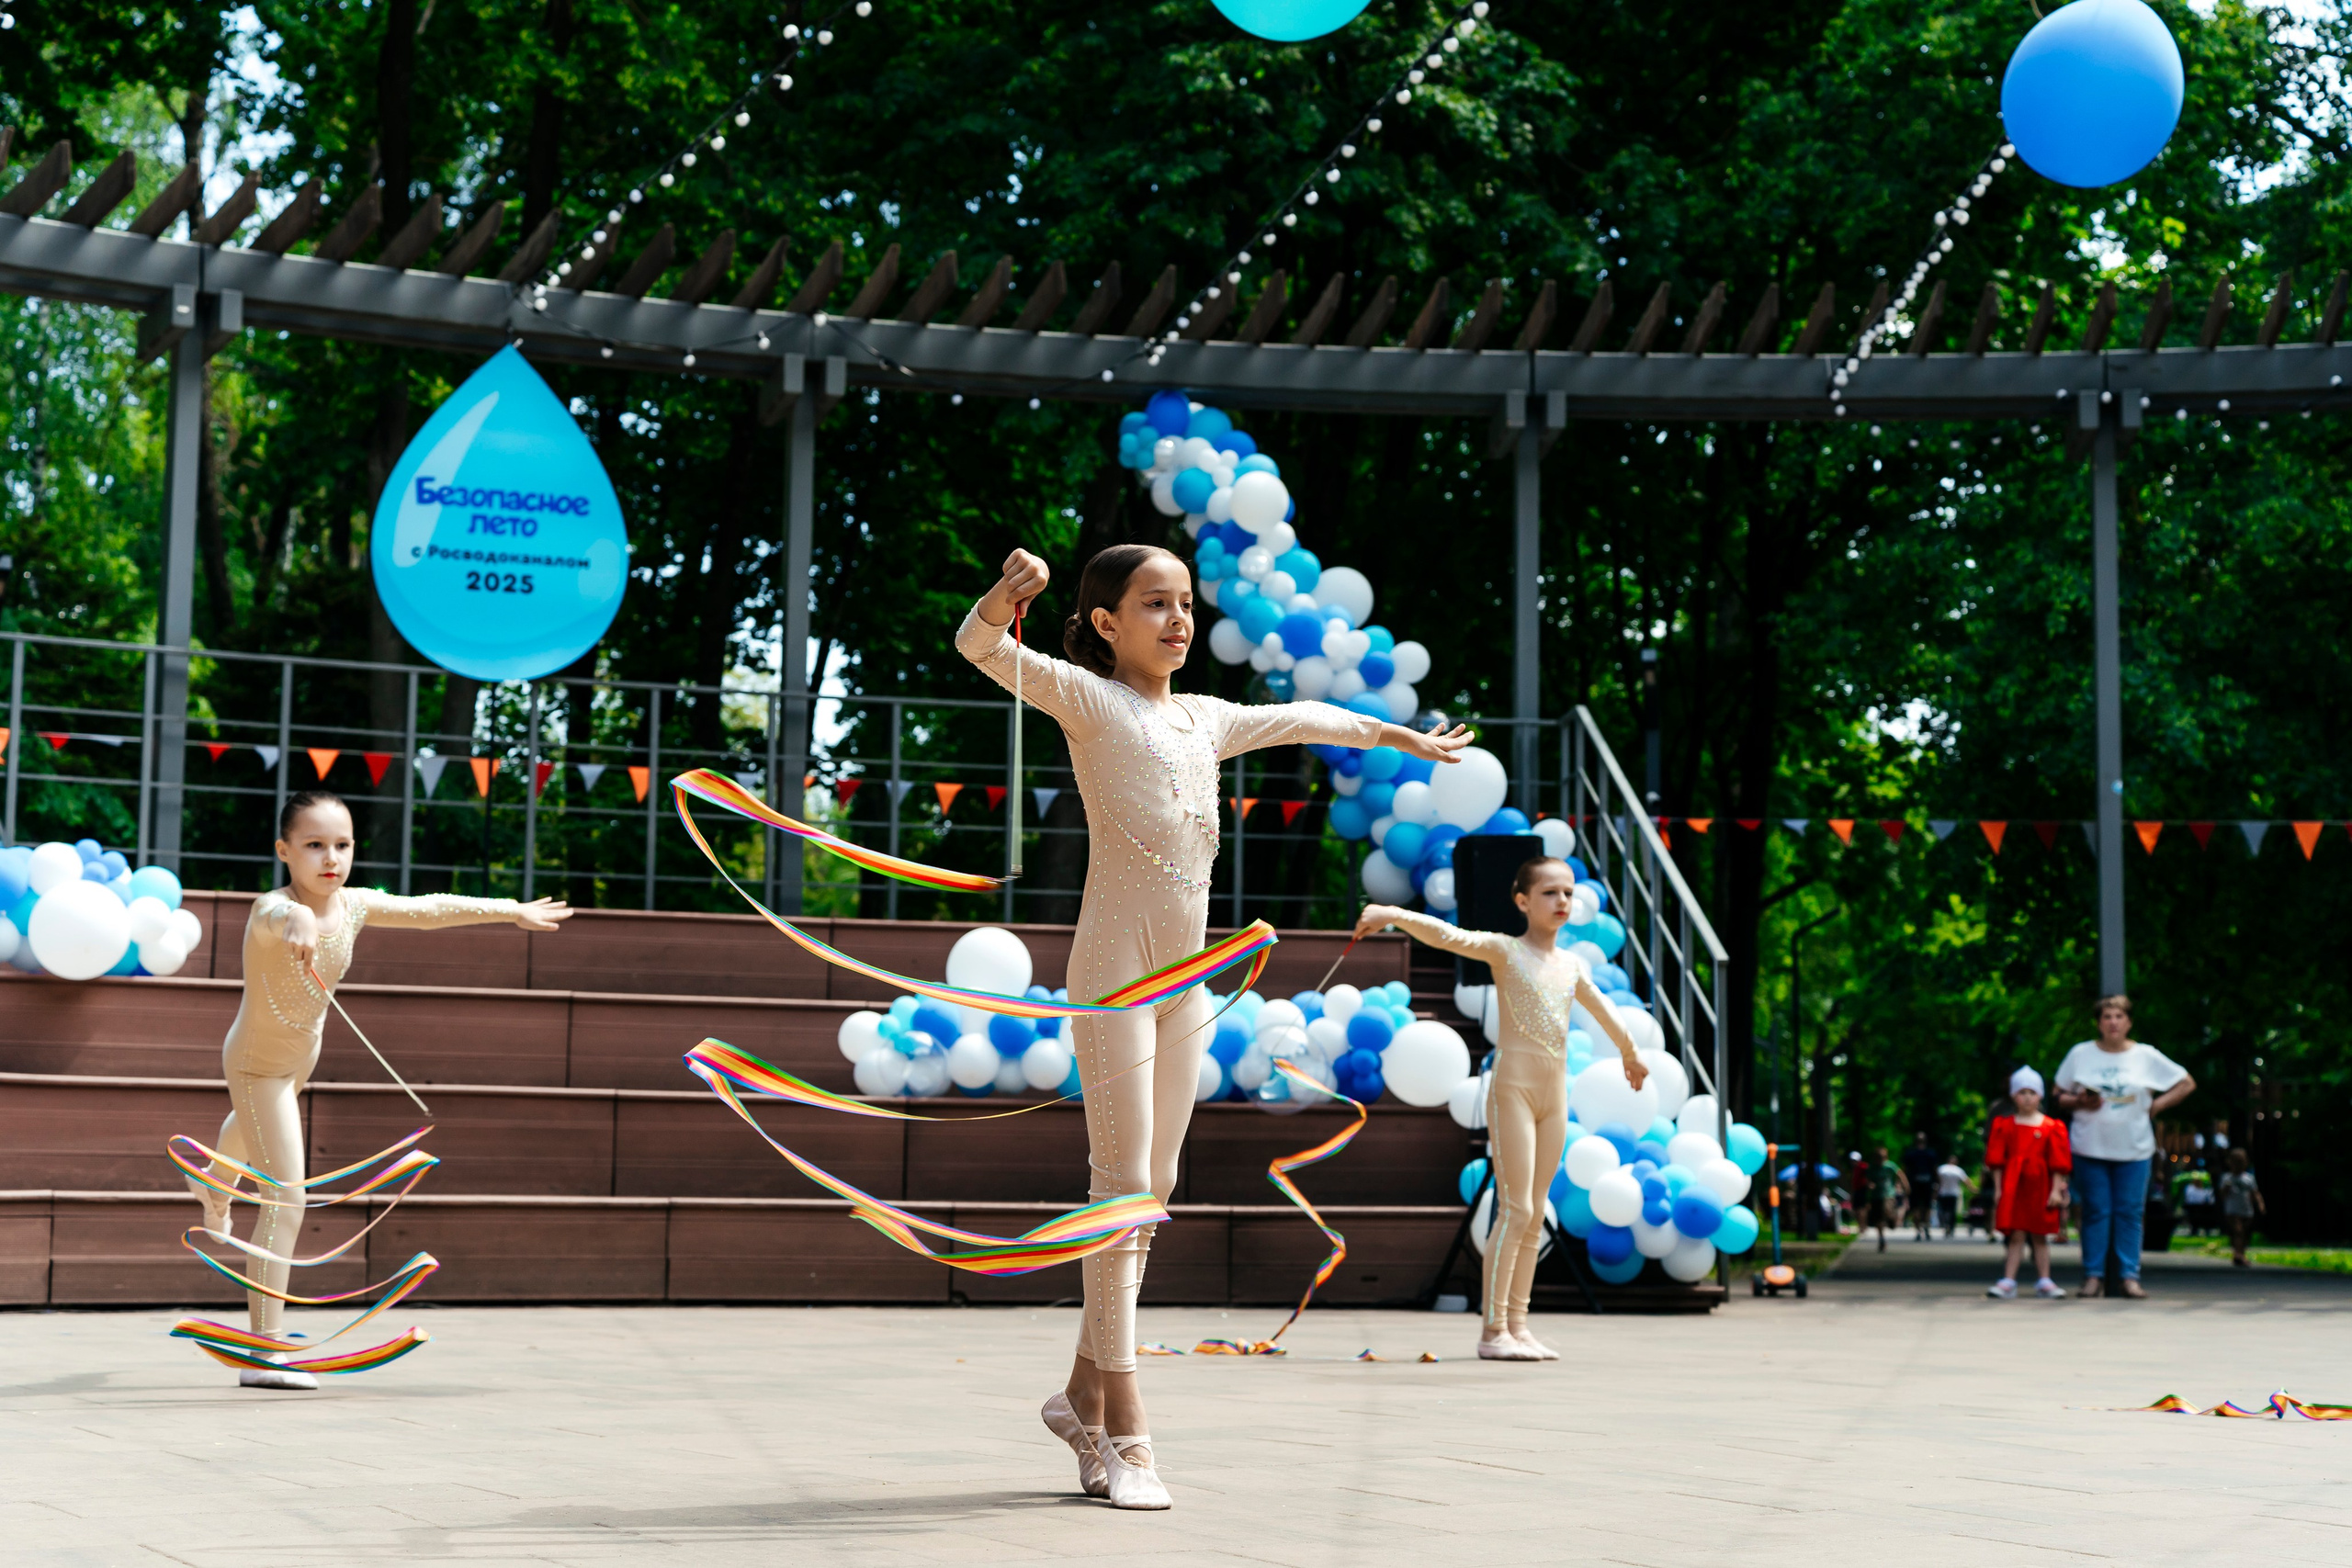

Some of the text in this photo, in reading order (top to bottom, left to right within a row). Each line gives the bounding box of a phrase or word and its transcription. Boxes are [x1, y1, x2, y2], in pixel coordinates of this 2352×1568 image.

[416, 476, 590, 516] Безопасное
[411, 545, 591, 569] с Росводоканалом
[466, 571, 535, 593] 2025
